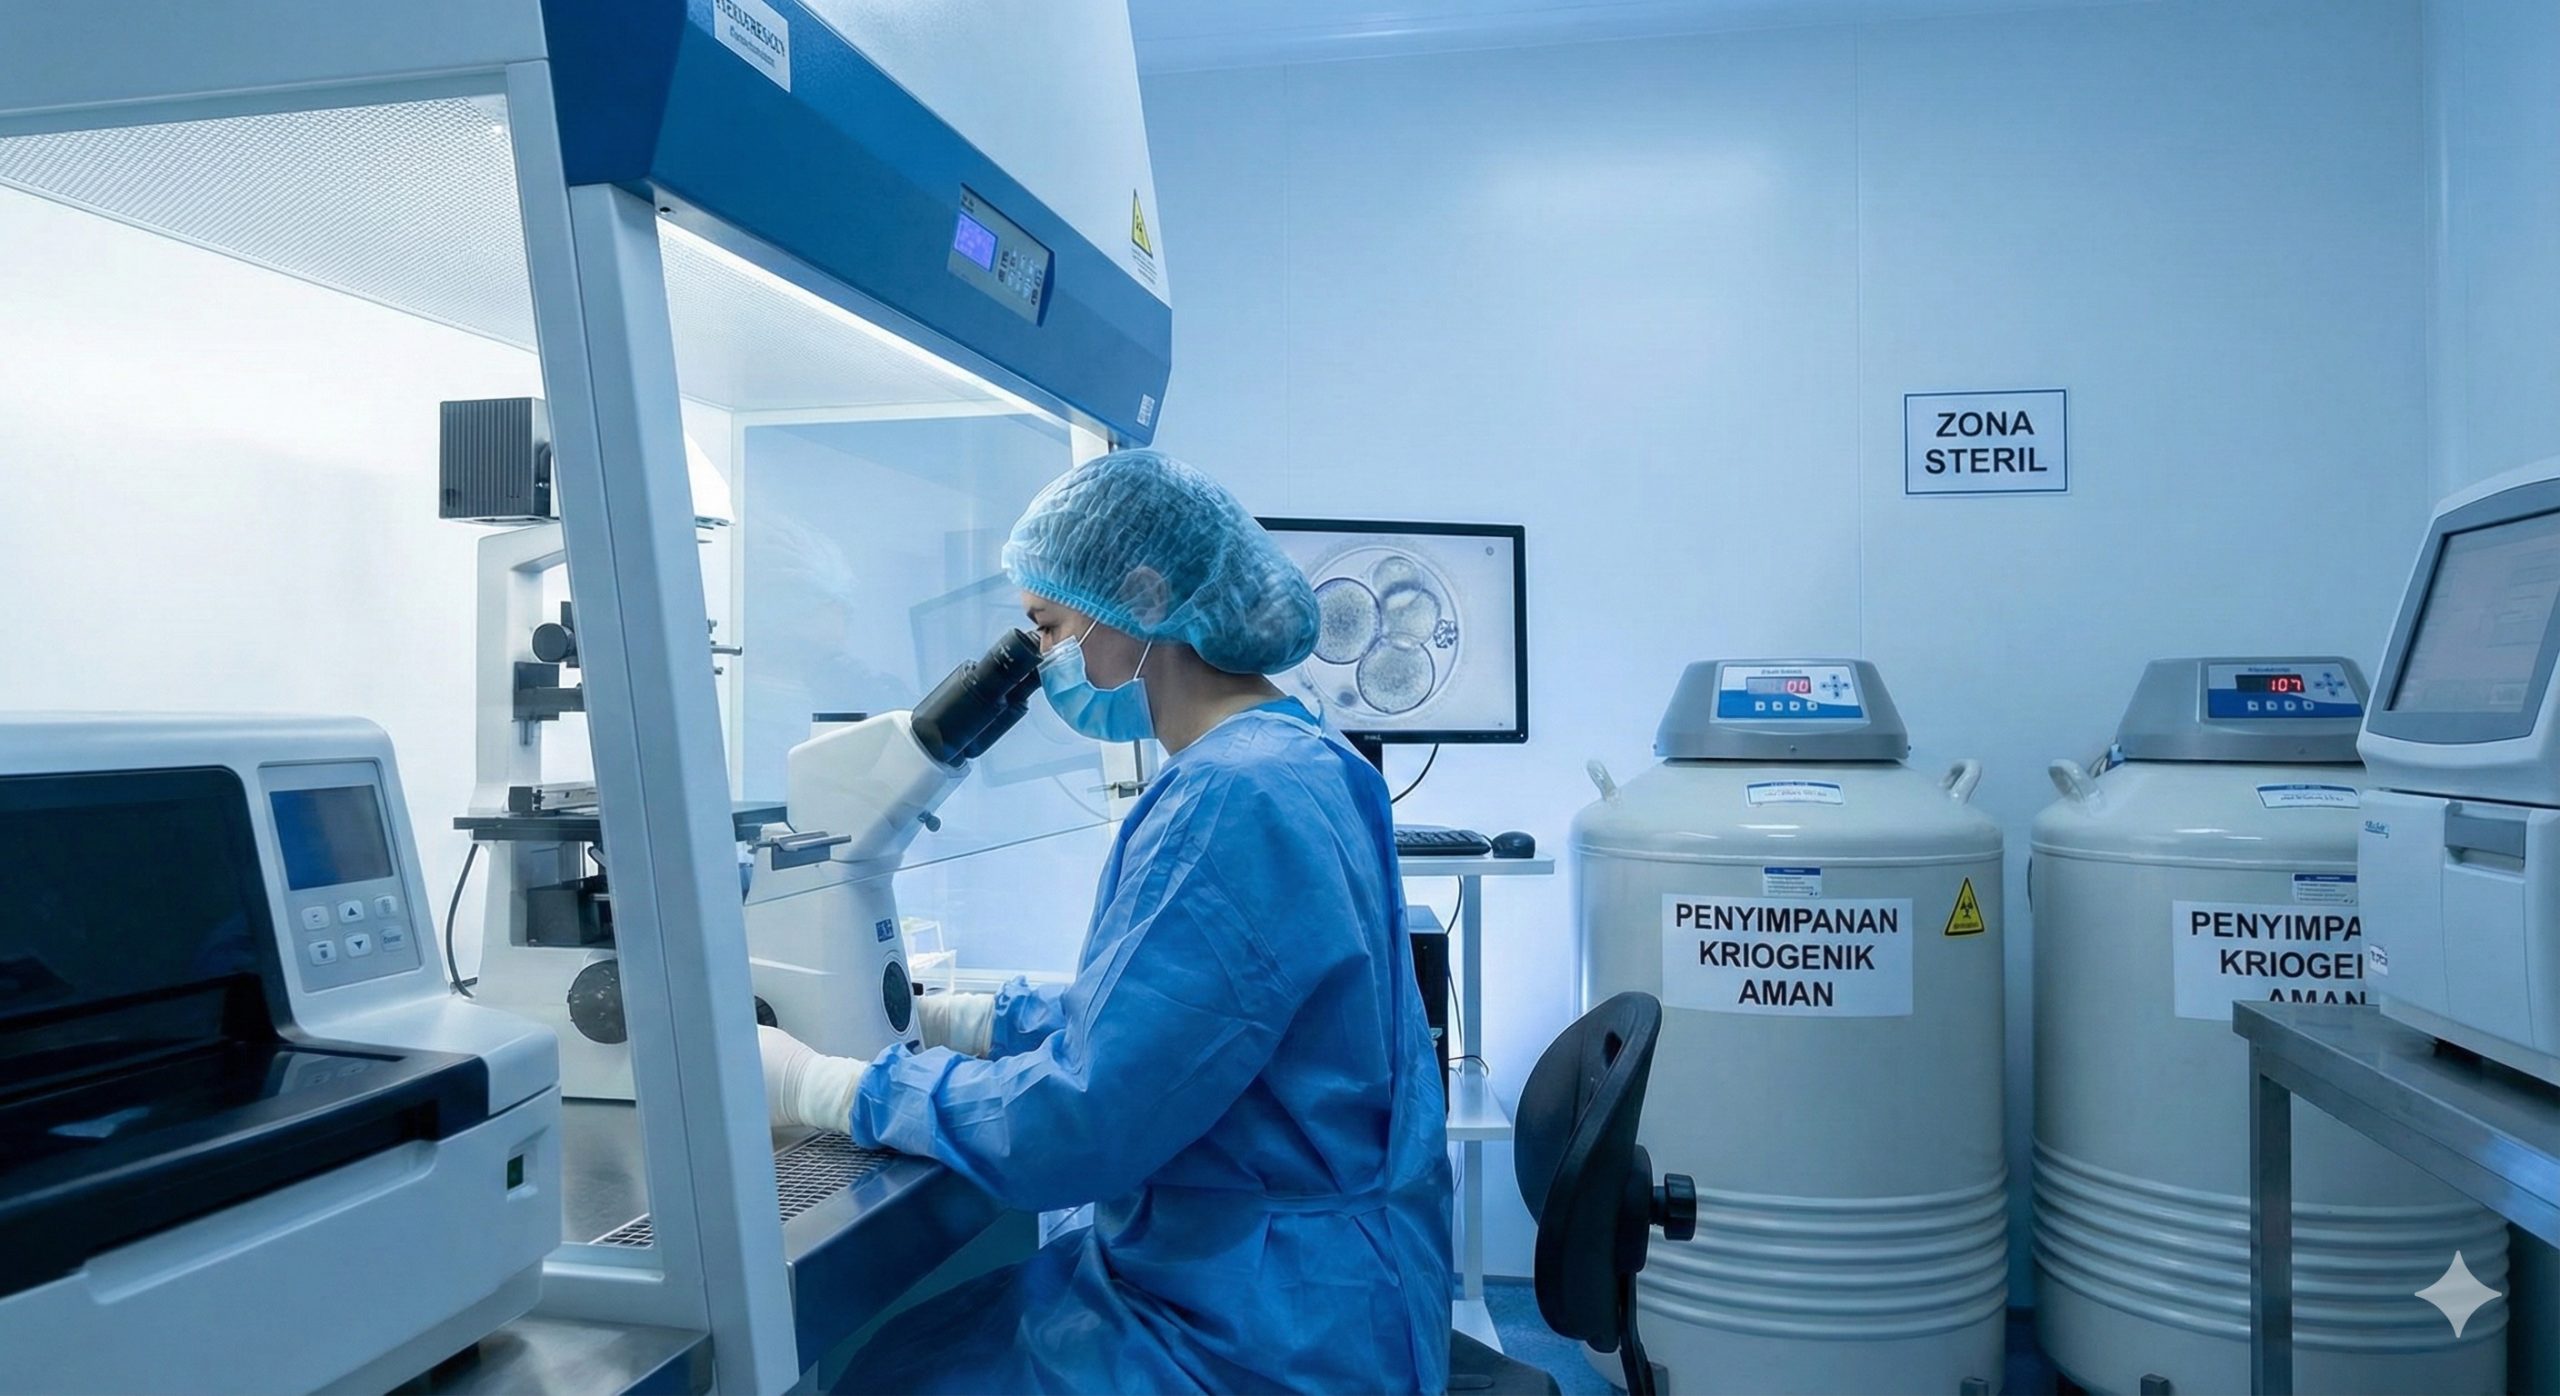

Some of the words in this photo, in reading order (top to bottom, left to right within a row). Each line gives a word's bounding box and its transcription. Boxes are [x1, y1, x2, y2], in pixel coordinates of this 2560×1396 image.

[1935, 410, 2035, 438] ZONA
[1924, 447, 2048, 475] STERIL
[2271, 678, 2302, 692] 107
[1675, 903, 1898, 934] PENYIMPANAN
[1699, 940, 1876, 970] KRIOGENIK
[2220, 949, 2364, 979] KRIOGE
[1737, 979, 1834, 1007] AMAN
